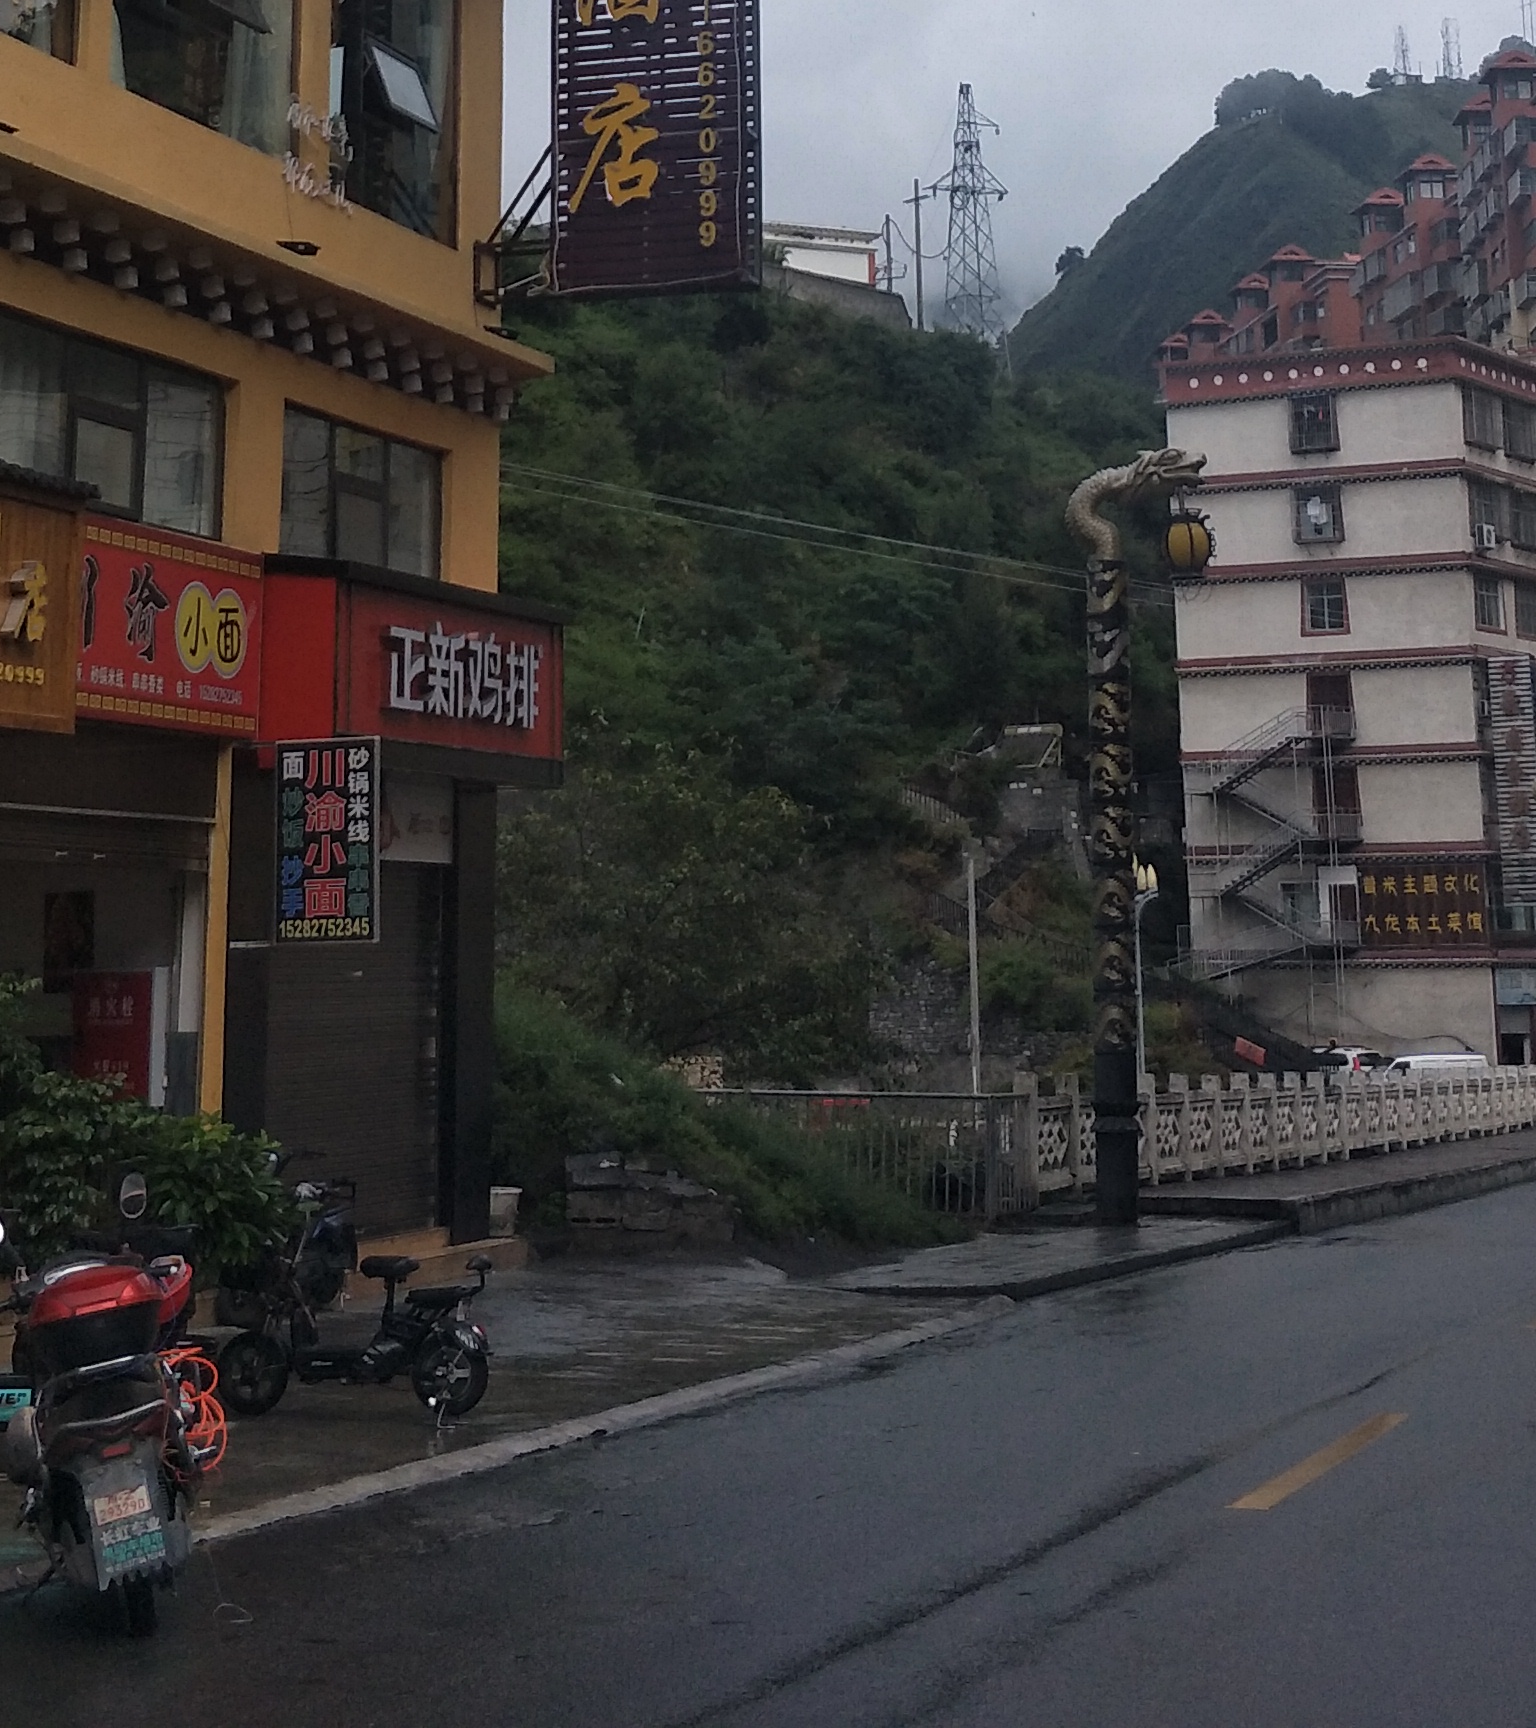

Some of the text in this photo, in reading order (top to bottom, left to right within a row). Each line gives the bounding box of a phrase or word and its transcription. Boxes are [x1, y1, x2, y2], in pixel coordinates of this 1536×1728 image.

[388, 621, 540, 730] 正新鸡排
[304, 747, 348, 919] 川渝小面
[278, 917, 371, 940] 15282752345
[1364, 911, 1485, 935] 九龙本土菜馆
